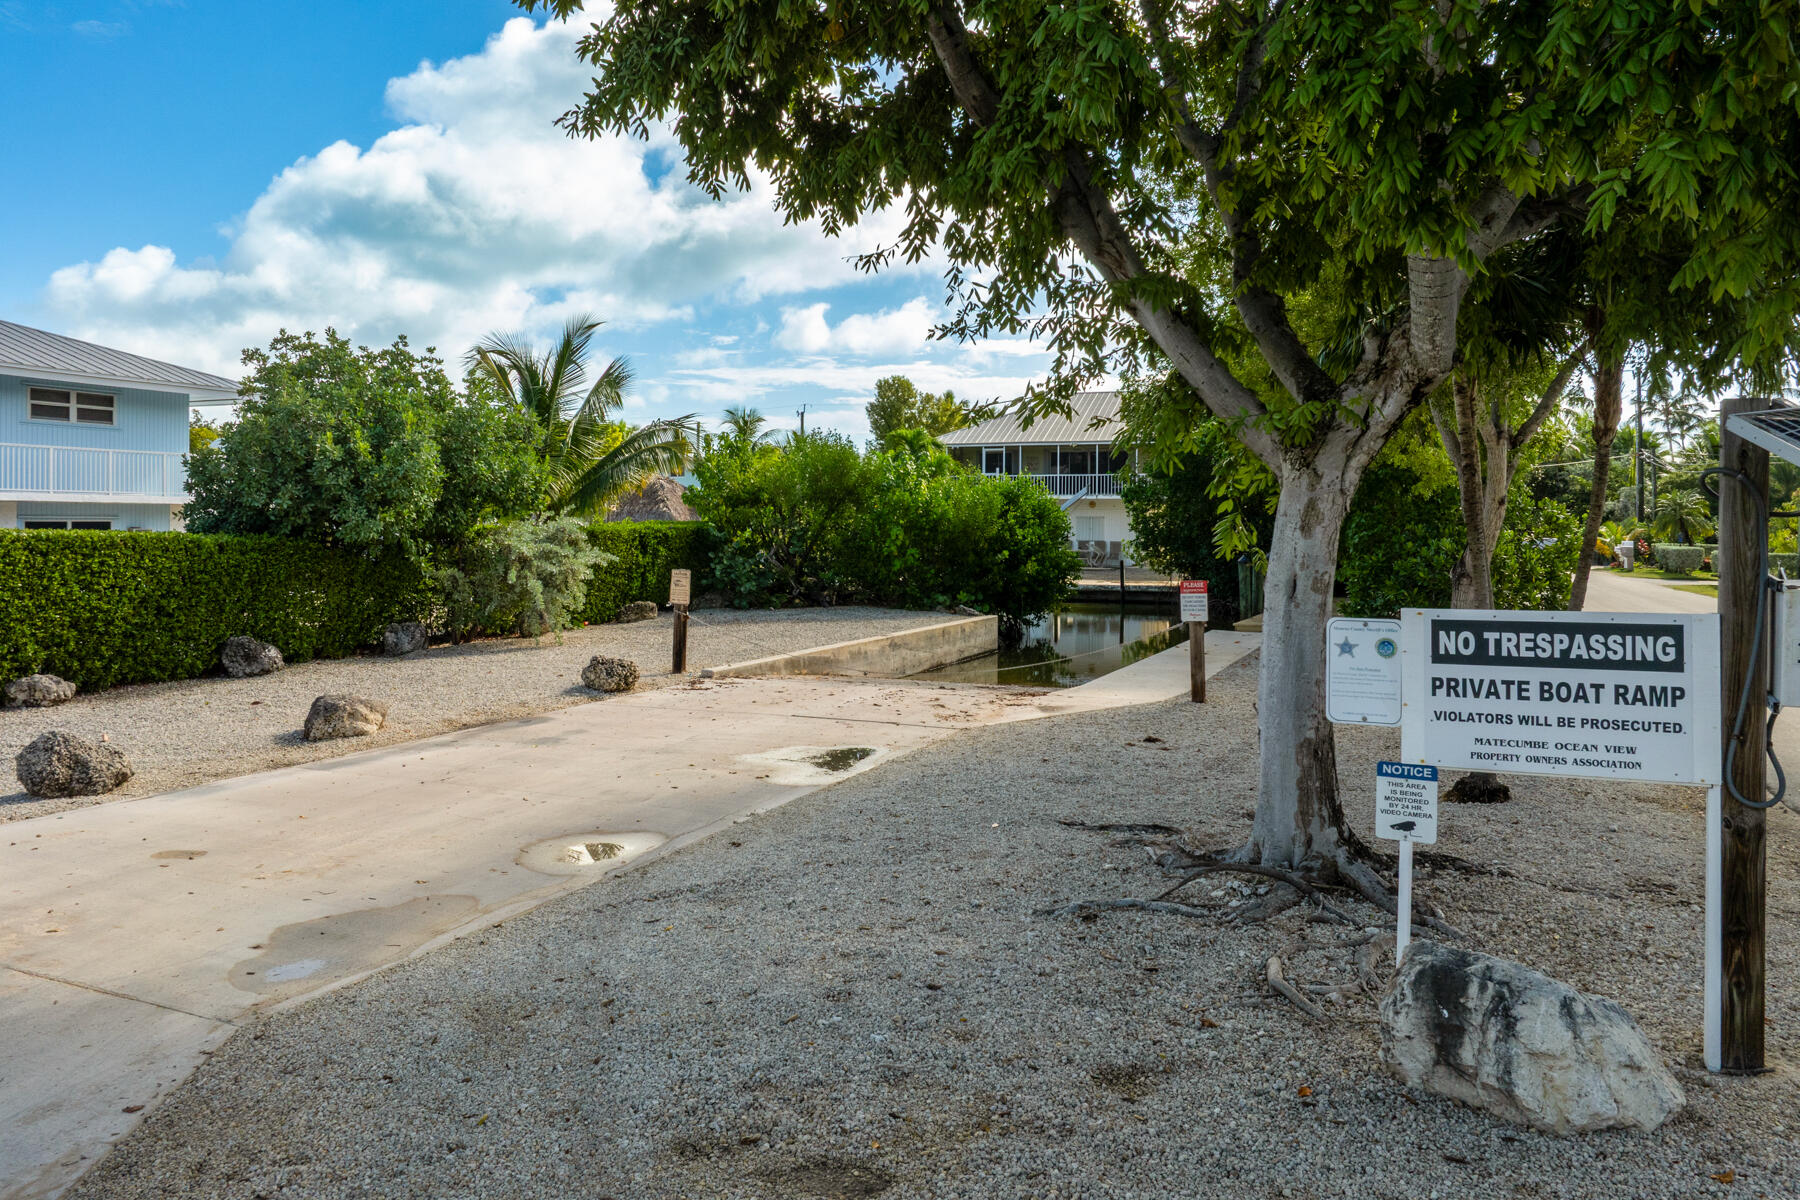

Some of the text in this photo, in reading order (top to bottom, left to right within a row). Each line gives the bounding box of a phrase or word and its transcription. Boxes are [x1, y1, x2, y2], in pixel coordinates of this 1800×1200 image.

[1439, 630, 1677, 663] NO TRESPASSING
[1431, 676, 1686, 708] PRIVATE BOAT RAMP
[1433, 710, 1514, 725] VIOLATORS
[1517, 714, 1553, 727] WILL
[1556, 716, 1576, 729] BE
[1474, 737, 1638, 755] MATECUMBE OCEAN VIEW
[1470, 751, 1642, 771] PROPERTY OWNERS ASSOCIATION
[1382, 764, 1432, 778] NOTICE
[1399, 790, 1423, 798] BEING
[1405, 783, 1427, 791] AREA
[1384, 795, 1429, 806] MONITORED
[1380, 808, 1433, 820] VIDEO CAMERA
